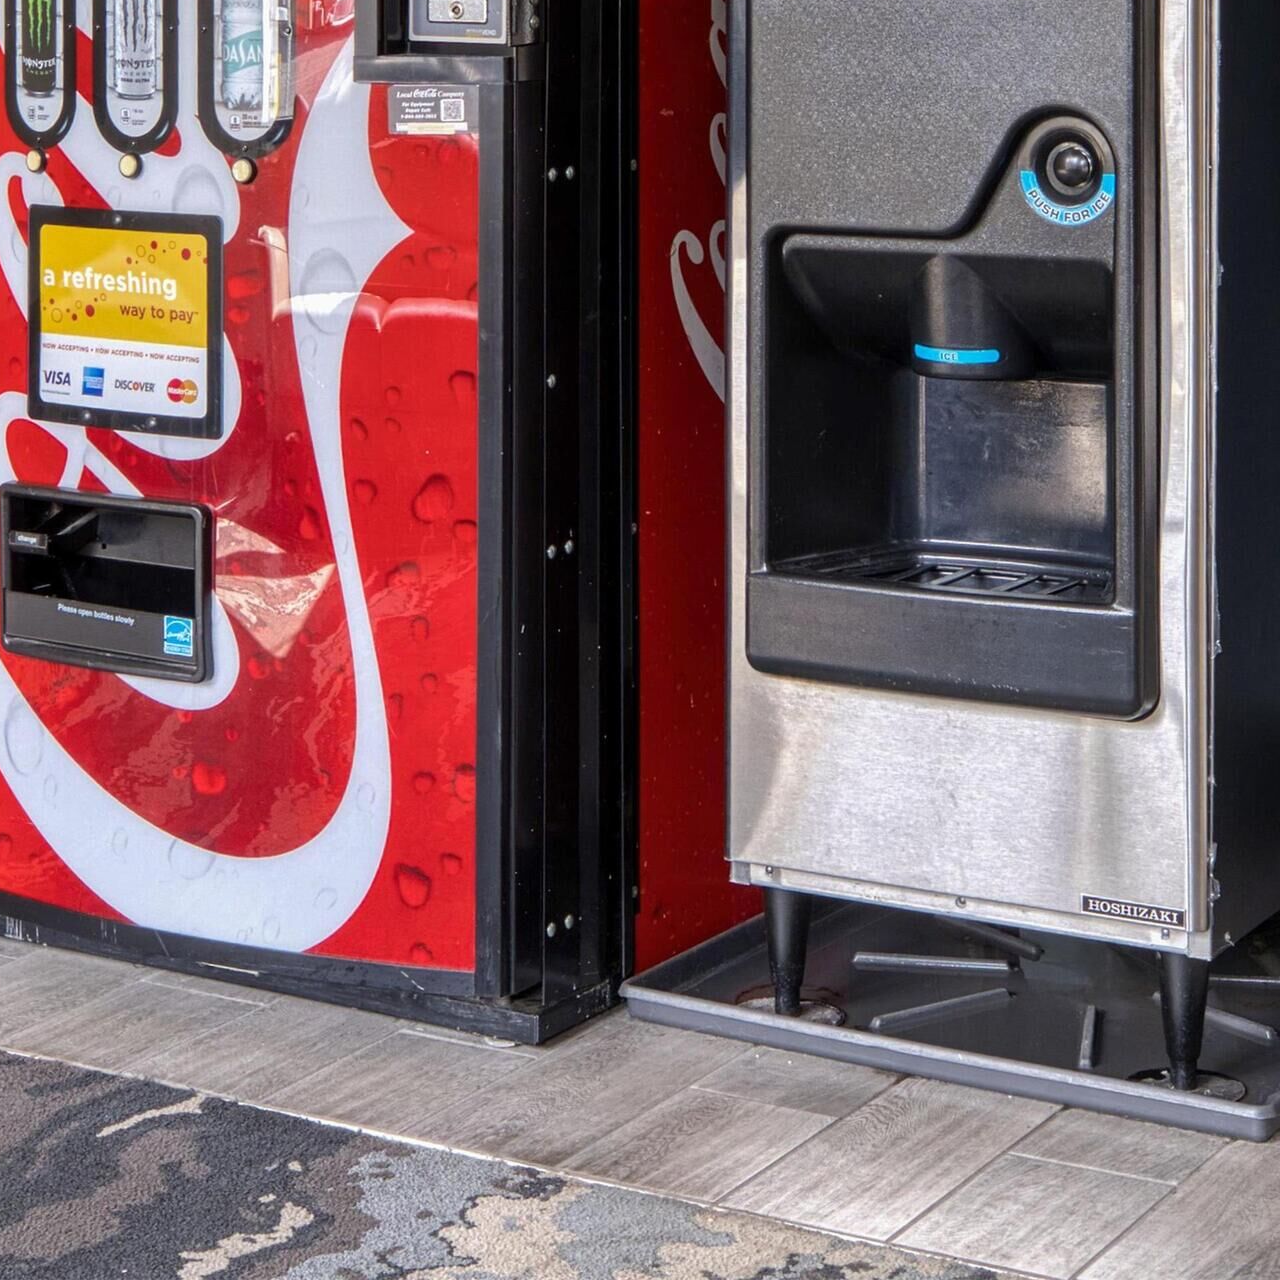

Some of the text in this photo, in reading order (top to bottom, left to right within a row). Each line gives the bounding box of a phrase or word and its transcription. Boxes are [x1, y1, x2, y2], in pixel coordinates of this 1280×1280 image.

[22, 55, 56, 69] MONSTER
[1027, 189, 1111, 223] PUSH FOR ICE
[43, 267, 178, 301] a refreshing
[119, 303, 147, 321] way
[151, 304, 166, 319] to
[59, 343, 90, 353] ACCEPTING
[111, 348, 145, 359] ACCEPTING
[149, 352, 165, 361] NOW
[167, 354, 200, 364] ACCEPTING
[939, 352, 957, 361] ICE
[43, 369, 71, 387] VISA
[114, 379, 156, 393] DISCOVER
[167, 384, 199, 398] MasterCard
[57, 602, 136, 627] Please open bottles slowly
[1086, 898, 1179, 925] HOSHIZAKI
